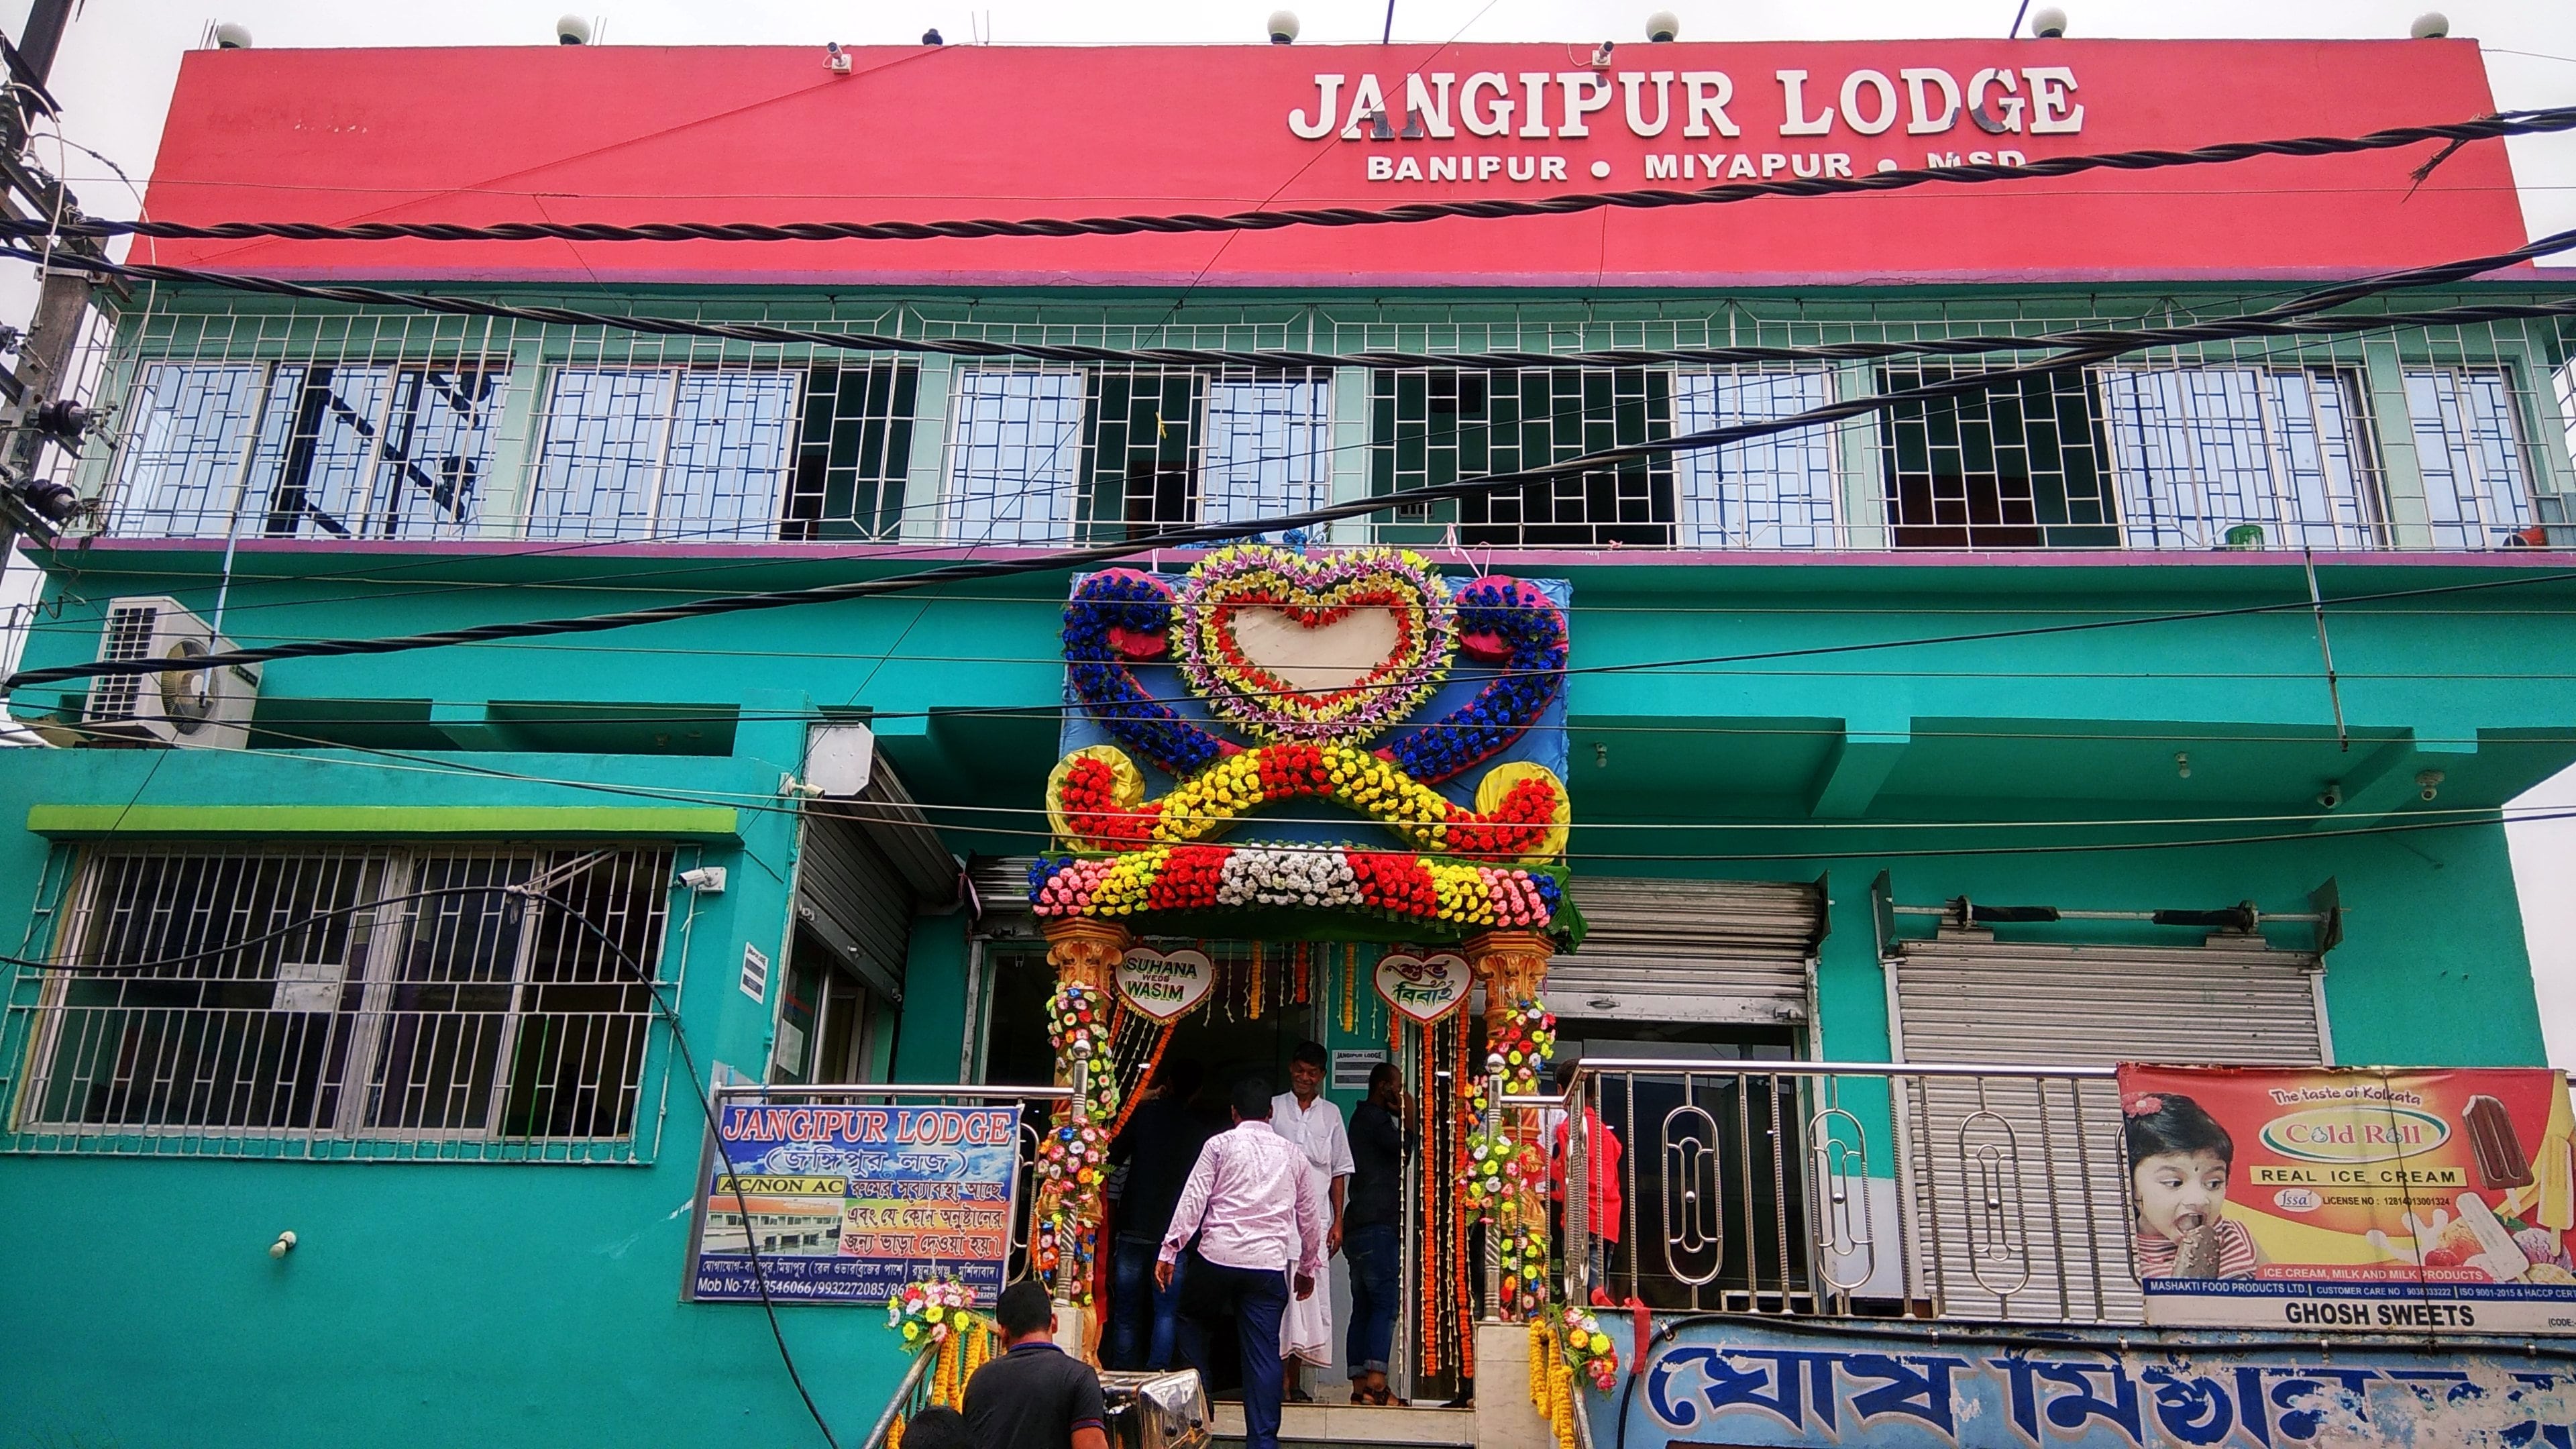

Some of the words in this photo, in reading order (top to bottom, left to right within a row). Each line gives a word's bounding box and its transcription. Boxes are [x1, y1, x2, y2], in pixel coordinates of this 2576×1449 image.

[1288, 70, 1741, 140] JANGIPUR
[1778, 66, 2086, 136] LODGE
[1366, 155, 1568, 182] BANIPUR
[1644, 152, 1854, 180] MIYAPUR
[1124, 957, 1197, 979] SUHANA
[1142, 974, 1170, 983] WEDS
[1383, 960, 1450, 982] শুভ
[1126, 980, 1185, 1001] WASIM
[1392, 980, 1456, 1006] বিবাহ
[1336, 1051, 1362, 1059] JANGIPUR
[1364, 1051, 1383, 1059] LODGE
[2271, 1090, 2300, 1104] The
[2302, 1086, 2341, 1100] taste
[2345, 1087, 2359, 1098] of
[2363, 1085, 2421, 1106] Kolkata
[723, 1109, 888, 1142] JANGIPUR
[898, 1112, 1011, 1144] LODGE
[2285, 1124, 2356, 1144] Cold
[2364, 1124, 2422, 1144] Roll
[720, 1179, 804, 1193] AC/NON
[812, 1180, 843, 1193] AC
[2261, 1169, 2317, 1182] REAL
[2331, 1170, 2366, 1183] ICE
[2380, 1171, 2455, 1183] CREAM
[851, 1180, 894, 1199] রুমের
[965, 1181, 1006, 1202] আছে
[2322, 1196, 2358, 1205] LICENSE
[847, 1208, 878, 1227] এবং
[881, 1208, 899, 1227] যে
[902, 1208, 936, 1228] কোন
[845, 1234, 875, 1254] জন্য
[880, 1234, 916, 1256] ভাড়া
[920, 1233, 965, 1256] দেওয়া
[697, 1277, 722, 1293] Mob
[2263, 1268, 2282, 1278] ICE
[2285, 1269, 2330, 1280] CREAM,
[2332, 1269, 2361, 1279] MILK
[2362, 1270, 2386, 1280] AND
[2389, 1270, 2417, 1280] MILK
[2421, 1271, 2483, 1281] PRODUCTS
[2150, 1281, 2200, 1291] MASHAKTI
[2202, 1282, 2230, 1292] FOOD
[2232, 1282, 2285, 1293] PRODUCTS
[2287, 1283, 2308, 1294] LTD.
[2316, 1286, 2362, 1295] CUSTOMER
[2363, 1287, 2386, 1296] CARE
[2459, 1288, 2474, 1297] ISO
[2475, 1288, 2516, 1297] 9001-2015
[2516, 1289, 2523, 1297] &
[2524, 1289, 2554, 1298] HACCP
[2285, 1301, 2371, 1326] GHOSH
[2377, 1303, 2475, 1327] SWEETS
[1644, 1344, 1978, 1444] ঘোষ
